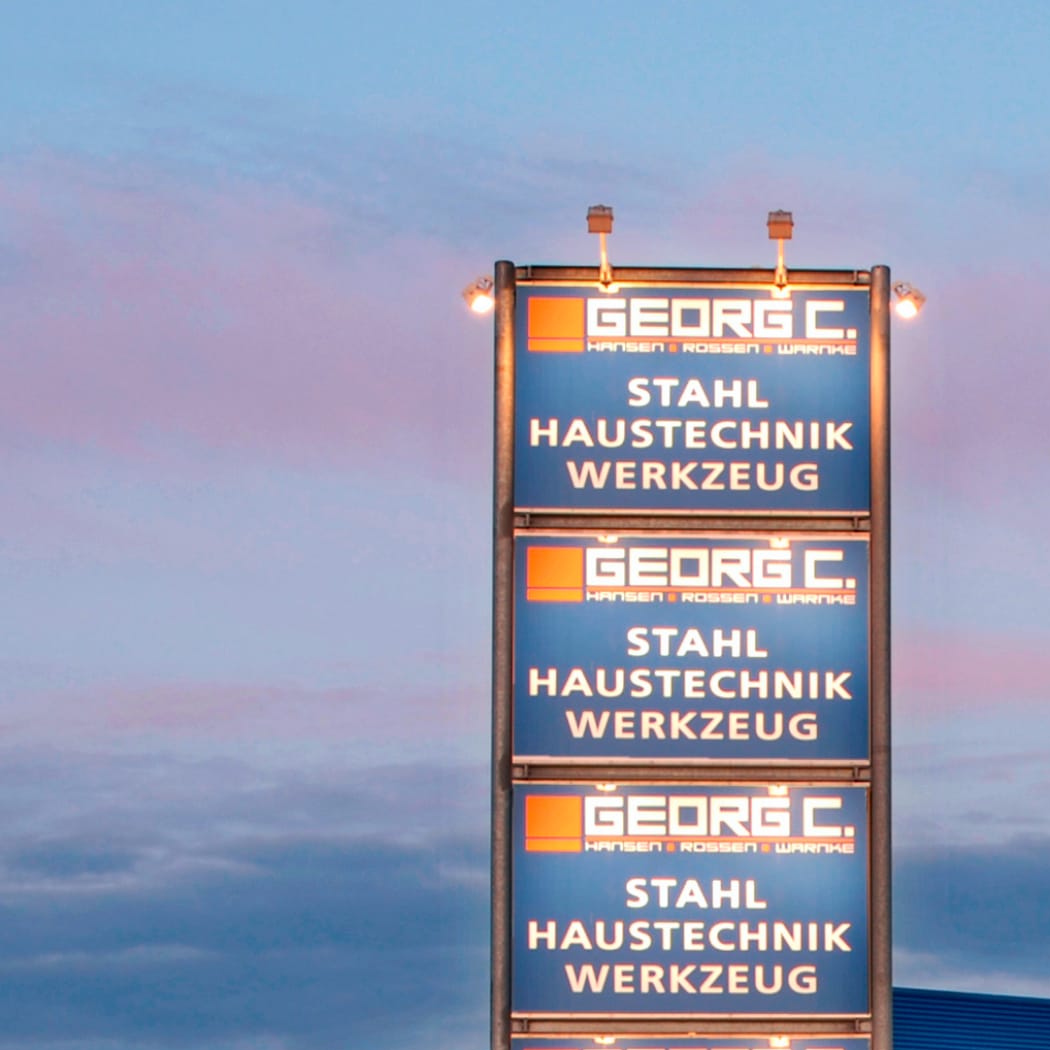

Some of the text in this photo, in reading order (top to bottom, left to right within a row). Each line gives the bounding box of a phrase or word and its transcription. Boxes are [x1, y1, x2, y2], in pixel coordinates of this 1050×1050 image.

[587, 298, 793, 338] GEORG
[588, 341, 857, 355] HANSEN ROSSEN WARNKE
[627, 377, 769, 408] STAHL
[529, 419, 854, 451] HAUSTECHNIK
[566, 461, 819, 491] WERKZEUG
[585, 547, 792, 588] GEORG
[586, 591, 856, 605] HANSEN ROSSEN WARNKE
[626, 626, 768, 658] STAHL
[528, 668, 853, 700] HAUSTECHNIK
[565, 710, 819, 741] WERKZEUG
[584, 796, 791, 837] GEORG
[584, 841, 855, 854] HANSEN ROSSEN WARNKE
[625, 878, 767, 909] STAHL
[527, 921, 852, 952] HAUSTECHNIK
[564, 963, 818, 995] WERKZEUG
